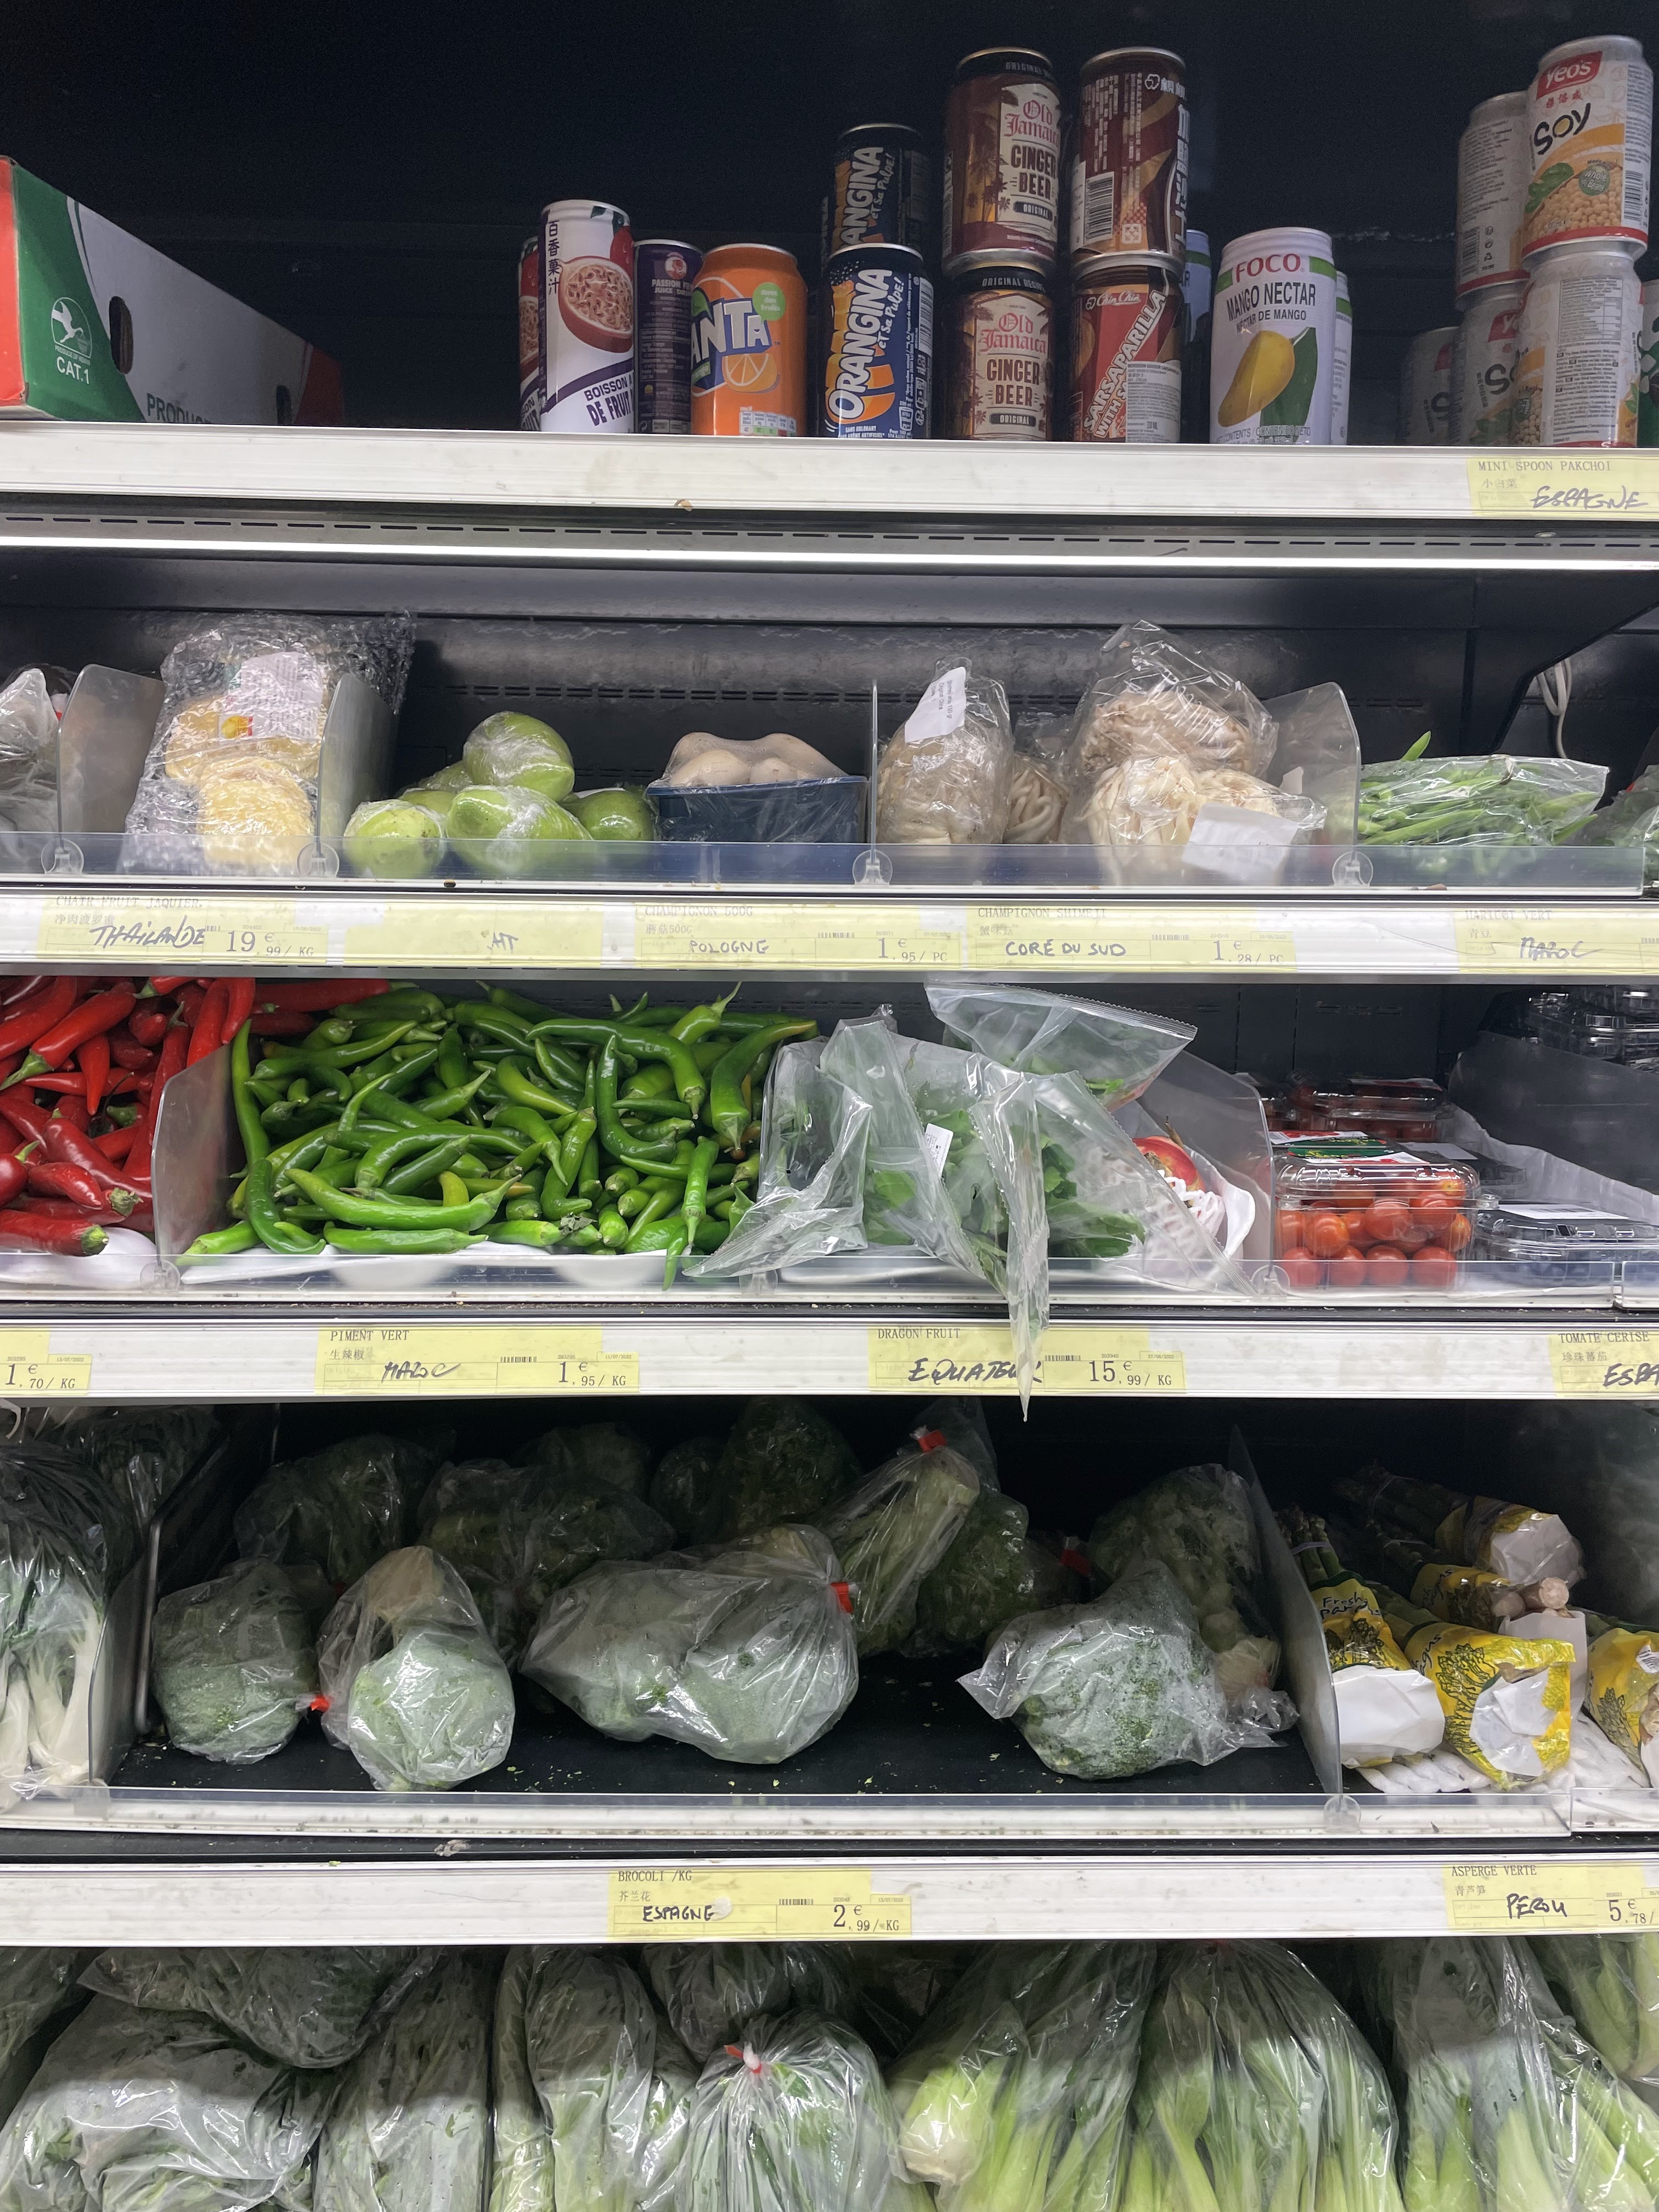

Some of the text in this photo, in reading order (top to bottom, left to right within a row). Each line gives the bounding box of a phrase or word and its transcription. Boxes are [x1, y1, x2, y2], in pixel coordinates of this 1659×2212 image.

[1023, 100, 1052, 126] Old
[1011, 144, 1056, 179] GINGER
[1019, 172, 1051, 200] BEER
[840, 146, 883, 245] ANGINA
[1236, 253, 1301, 283] FOCO
[652, 279, 681, 288] PASSION
[982, 277, 1022, 286] ORIGINAL
[1227, 282, 1316, 321] MANGO NECTAR
[1259, 310, 1270, 321] DE
[1273, 309, 1306, 320] MANGO
[998, 312, 1033, 334] Old
[691, 301, 771, 370] ANTA
[979, 329, 1046, 354] Jamaica
[828, 269, 893, 419] ORANGINA
[1084, 290, 1165, 433] SARSAPARILLA
[57, 356, 89, 385] CAT.1
[987, 359, 1040, 385] GINGER
[584, 377, 628, 401] BOISSON
[995, 385, 1032, 407] BEER
[586, 400, 607, 426] DE
[605, 390, 630, 420] FRUIT
[1000, 415, 1030, 425] ORIGINAL
[1094, 398, 1122, 437] WITH
[1478, 461, 1612, 471] MINI SPOON PAKCHOI
[1530, 486, 1649, 510] ESPAGNE
[645, 906, 753, 917] CHAMPIGNON 500G
[978, 907, 1107, 919] CHAMPIGNON SHIMEJI
[1522, 910, 1552, 921] VERT
[299, 946, 314, 957] KG
[689, 939, 769, 955] POLOGNE
[1062, 943, 1081, 954] DU
[1088, 943, 1126, 957] SUD
[933, 952, 948, 962] PC
[1269, 954, 1283, 964] PC
[330, 1329, 410, 1341] PIMENT VERT
[878, 1328, 961, 1339] DRAGON FRUIT
[1558, 1331, 1650, 1344] TOMATE CERISE
[60, 1378, 76, 1389] KG
[612, 1375, 627, 1386] KG
[1158, 1375, 1172, 1385] KG
[618, 1869, 692, 1882] BROCOLI /KG
[1452, 1865, 1537, 1877] ASPERGE VERTE
[642, 1904, 715, 1922] ESPAGNE
[886, 1920, 900, 1931] KG
